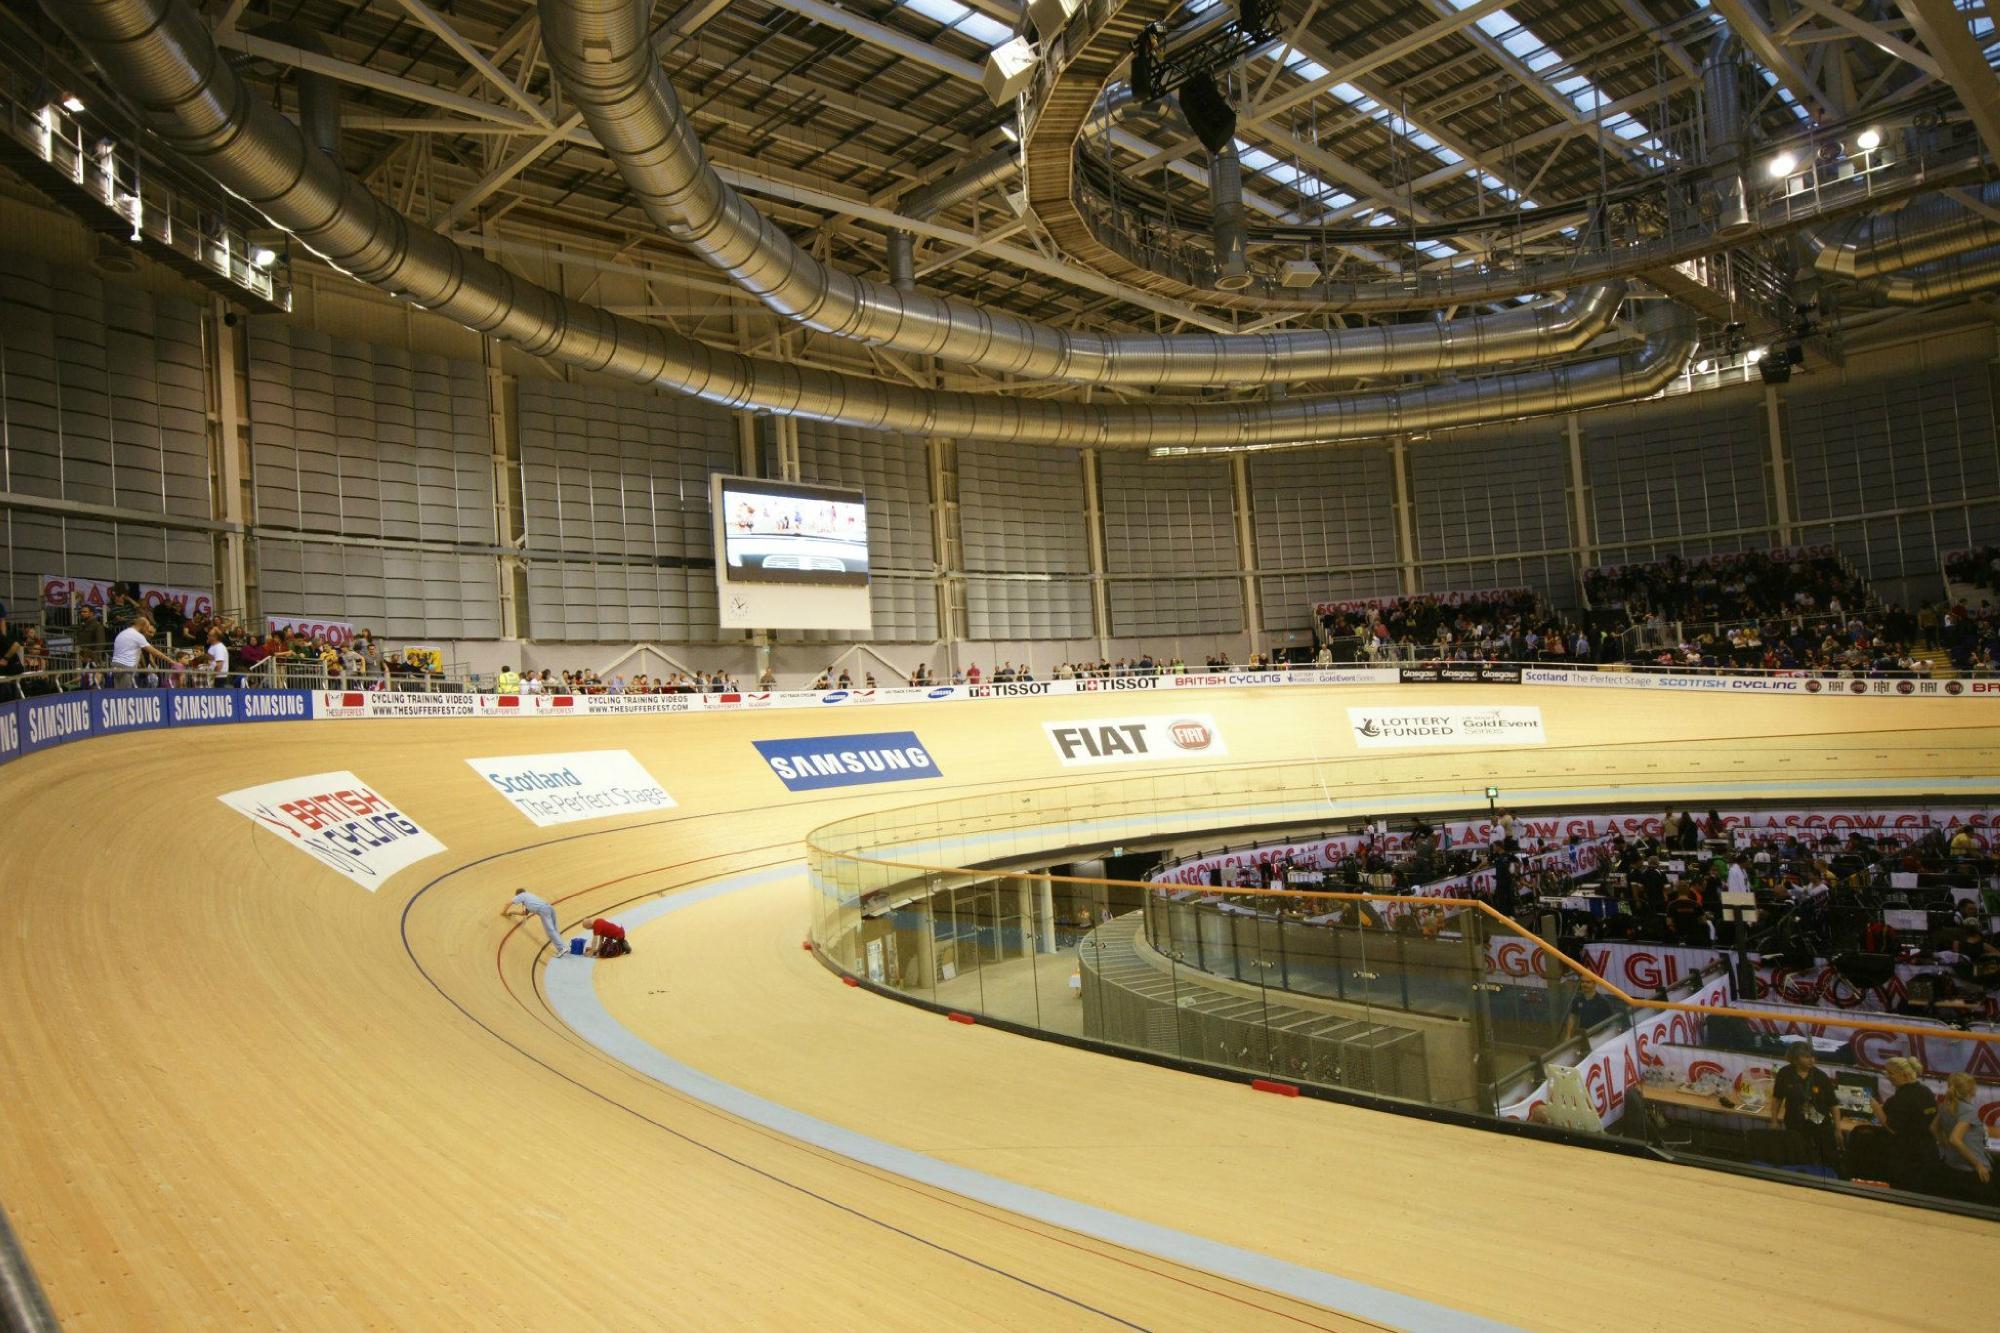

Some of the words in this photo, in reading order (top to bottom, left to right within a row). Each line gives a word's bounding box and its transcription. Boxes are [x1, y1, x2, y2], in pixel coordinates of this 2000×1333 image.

[1101, 677, 1159, 690] TISSOT
[1175, 676, 1226, 686] BRITISH
[1229, 674, 1281, 685] CYCLING
[1525, 671, 1568, 682] Scotland
[1573, 674, 1587, 682] The
[1590, 674, 1622, 685] Perfect
[1625, 676, 1651, 687] Stage
[1659, 678, 1726, 688] SCOTTISH
[1732, 680, 1797, 690] CYCLING
[1829, 681, 1844, 691] FIAT
[1874, 681, 1890, 692] FIAT
[1920, 682, 1937, 692] FIAT
[992, 682, 1051, 696] TISSOT
[244, 694, 304, 717] SAMSUNG
[371, 694, 405, 705] CYCLING
[407, 695, 443, 705] TRAINING
[445, 695, 473, 705] VIDEOS
[588, 696, 621, 705] CYCLING
[623, 696, 659, 704] TRAINING
[661, 695, 689, 704] VIDEOS
[101, 695, 161, 728] SAMSUNG
[174, 695, 233, 720] SAMSUNG
[372, 705, 474, 716] WWW.THESUFFERFEST.COM
[588, 704, 689, 713] WWW.THESUFFERFEST.COM
[28, 699, 90, 743] SAMSUNG
[1381, 717, 1450, 727] LOTTERY
[1384, 727, 1453, 736] FUNDED
[1052, 724, 1148, 759] FIAT
[770, 747, 930, 780] SAMSUNG
[489, 767, 582, 793] Scotland
[515, 796, 559, 817] The
[549, 790, 616, 815] Perfect
[611, 786, 668, 806] Stage
[279, 788, 391, 831] BRITISH
[323, 812, 420, 857] CYCLING
